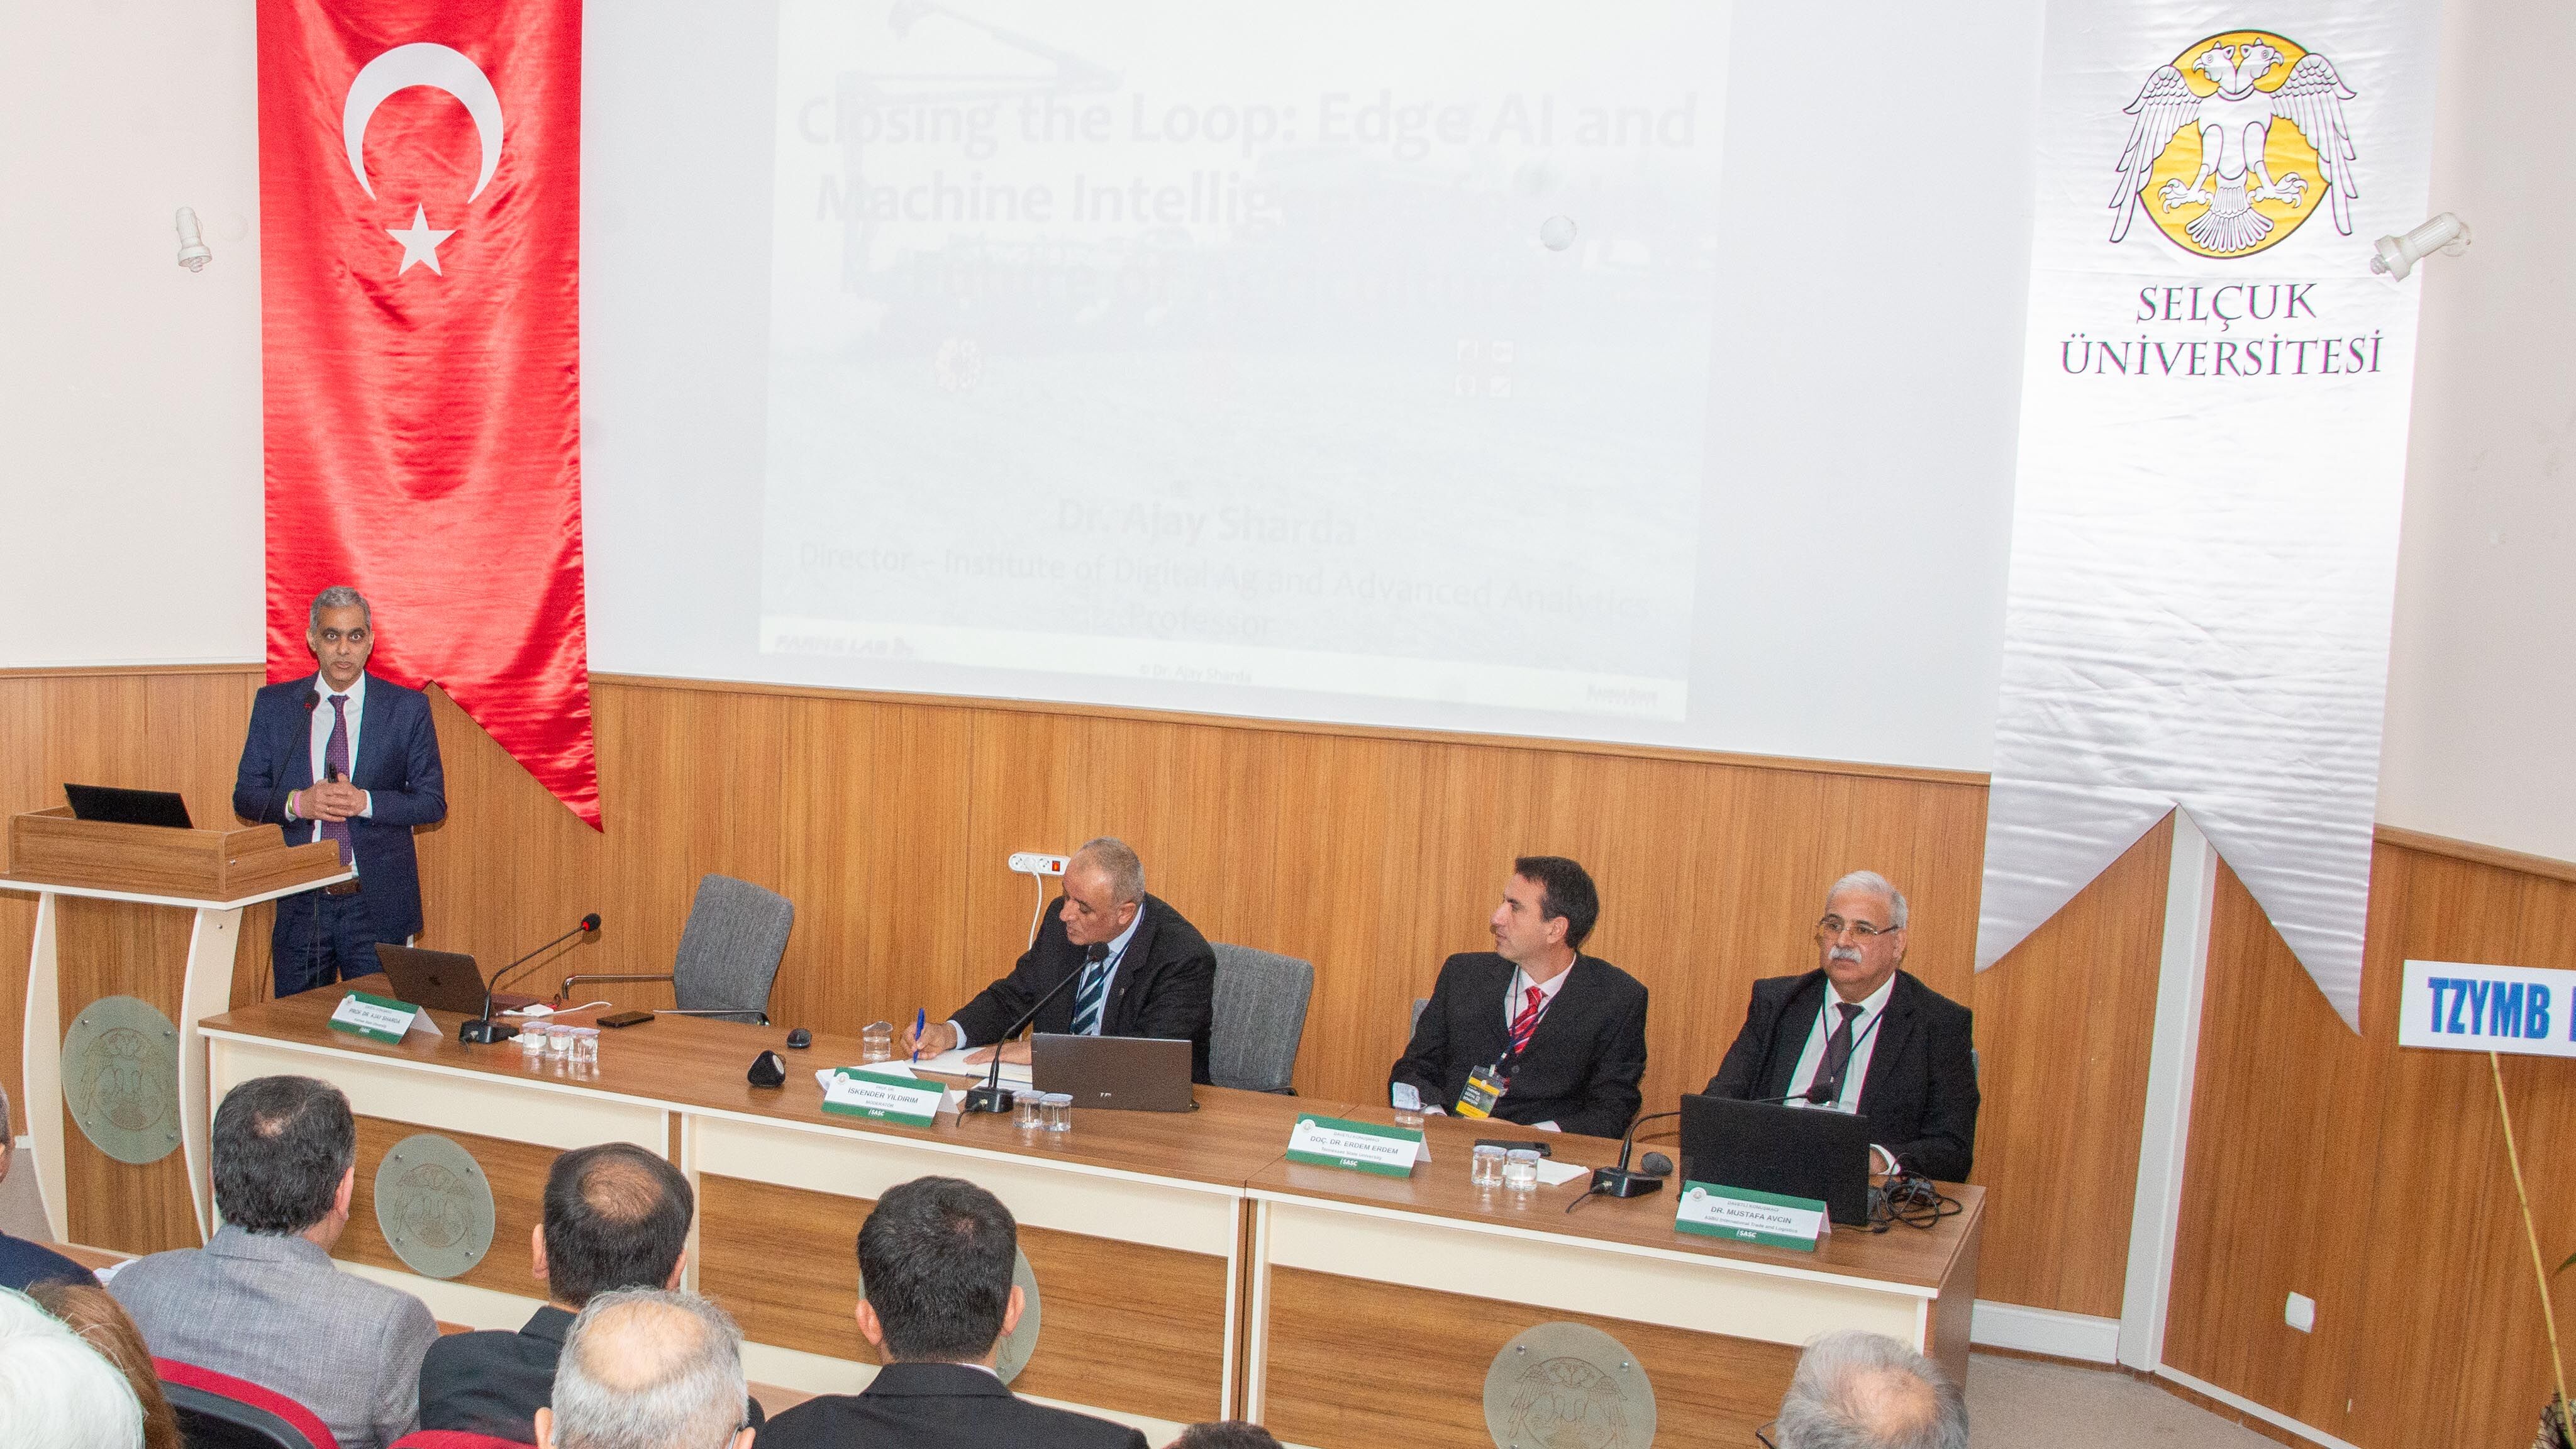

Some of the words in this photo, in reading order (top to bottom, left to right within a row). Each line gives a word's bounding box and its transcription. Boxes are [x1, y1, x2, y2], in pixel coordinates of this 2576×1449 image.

[797, 92, 1002, 160] Closing
[1017, 91, 1112, 143] the
[1132, 92, 1297, 160] Loop:
[1318, 88, 1473, 162] Edge
[1487, 92, 1554, 145] AI
[1575, 91, 1697, 148] and
[816, 169, 1054, 223] Machine
[2136, 283, 2318, 332] SELÇUK
[2060, 330, 2385, 377] ÜNİVERSİTESİ
[1057, 497, 1109, 533] Dr.
[1122, 500, 1206, 547] Ajay
[1218, 503, 1357, 547] Sharda
[799, 541, 912, 572] Director
[945, 546, 1066, 581] Institute
[1075, 553, 1107, 583] of
[1115, 556, 1210, 594] Digital
[1267, 565, 1323, 596] and
[1334, 567, 1491, 609] Advanced
[1503, 579, 1653, 625] Analytics
[1128, 601, 1272, 636] Professor
[2428, 977, 2550, 1039] TZYMB
[1344, 1141, 1370, 1151] ERDEM
[1372, 1145, 1398, 1155] ERDEM
[1727, 1208, 1765, 1221] MUSTAFA
[1767, 1215, 1792, 1224] AVCIN
